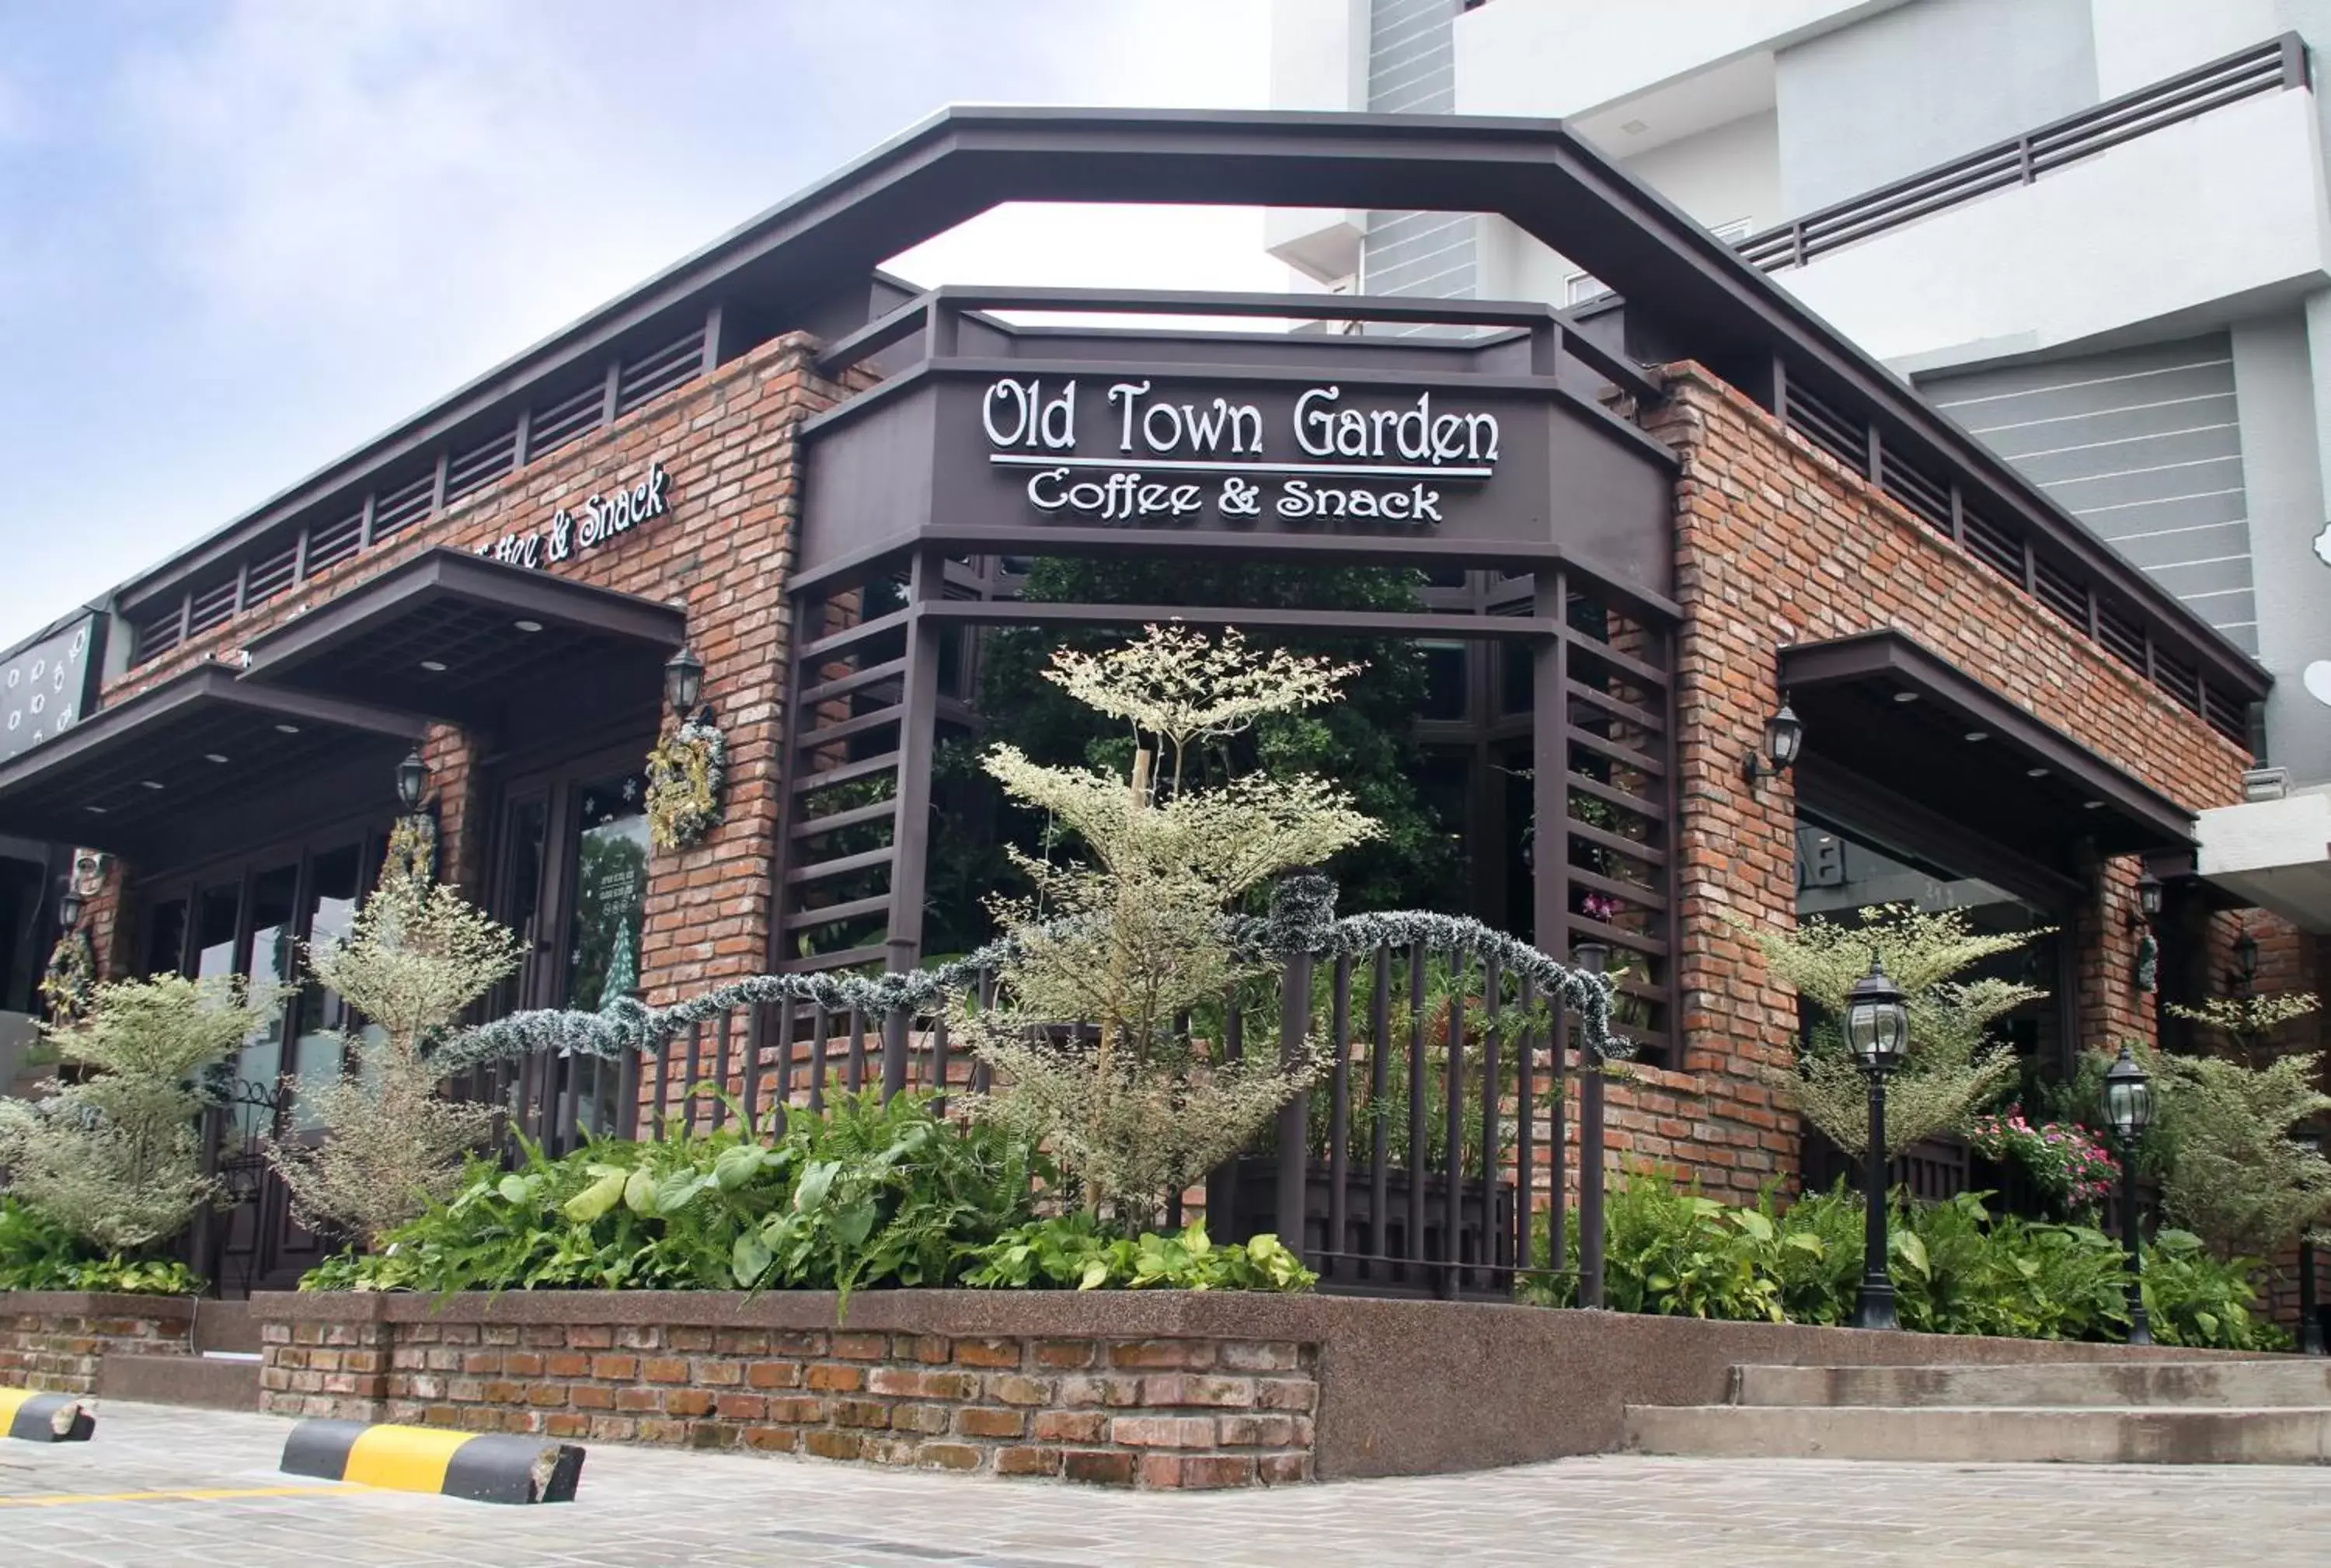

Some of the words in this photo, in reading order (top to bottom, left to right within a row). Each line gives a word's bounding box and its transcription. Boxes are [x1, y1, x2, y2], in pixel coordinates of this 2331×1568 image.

[982, 378, 1078, 450] Old
[1107, 380, 1263, 454] Town
[1293, 385, 1499, 465] Garden
[549, 509, 570, 561] &
[580, 463, 664, 547] Snack
[1027, 467, 1202, 520] Coffee
[1218, 476, 1260, 516] &
[1277, 479, 1442, 521] Snack
